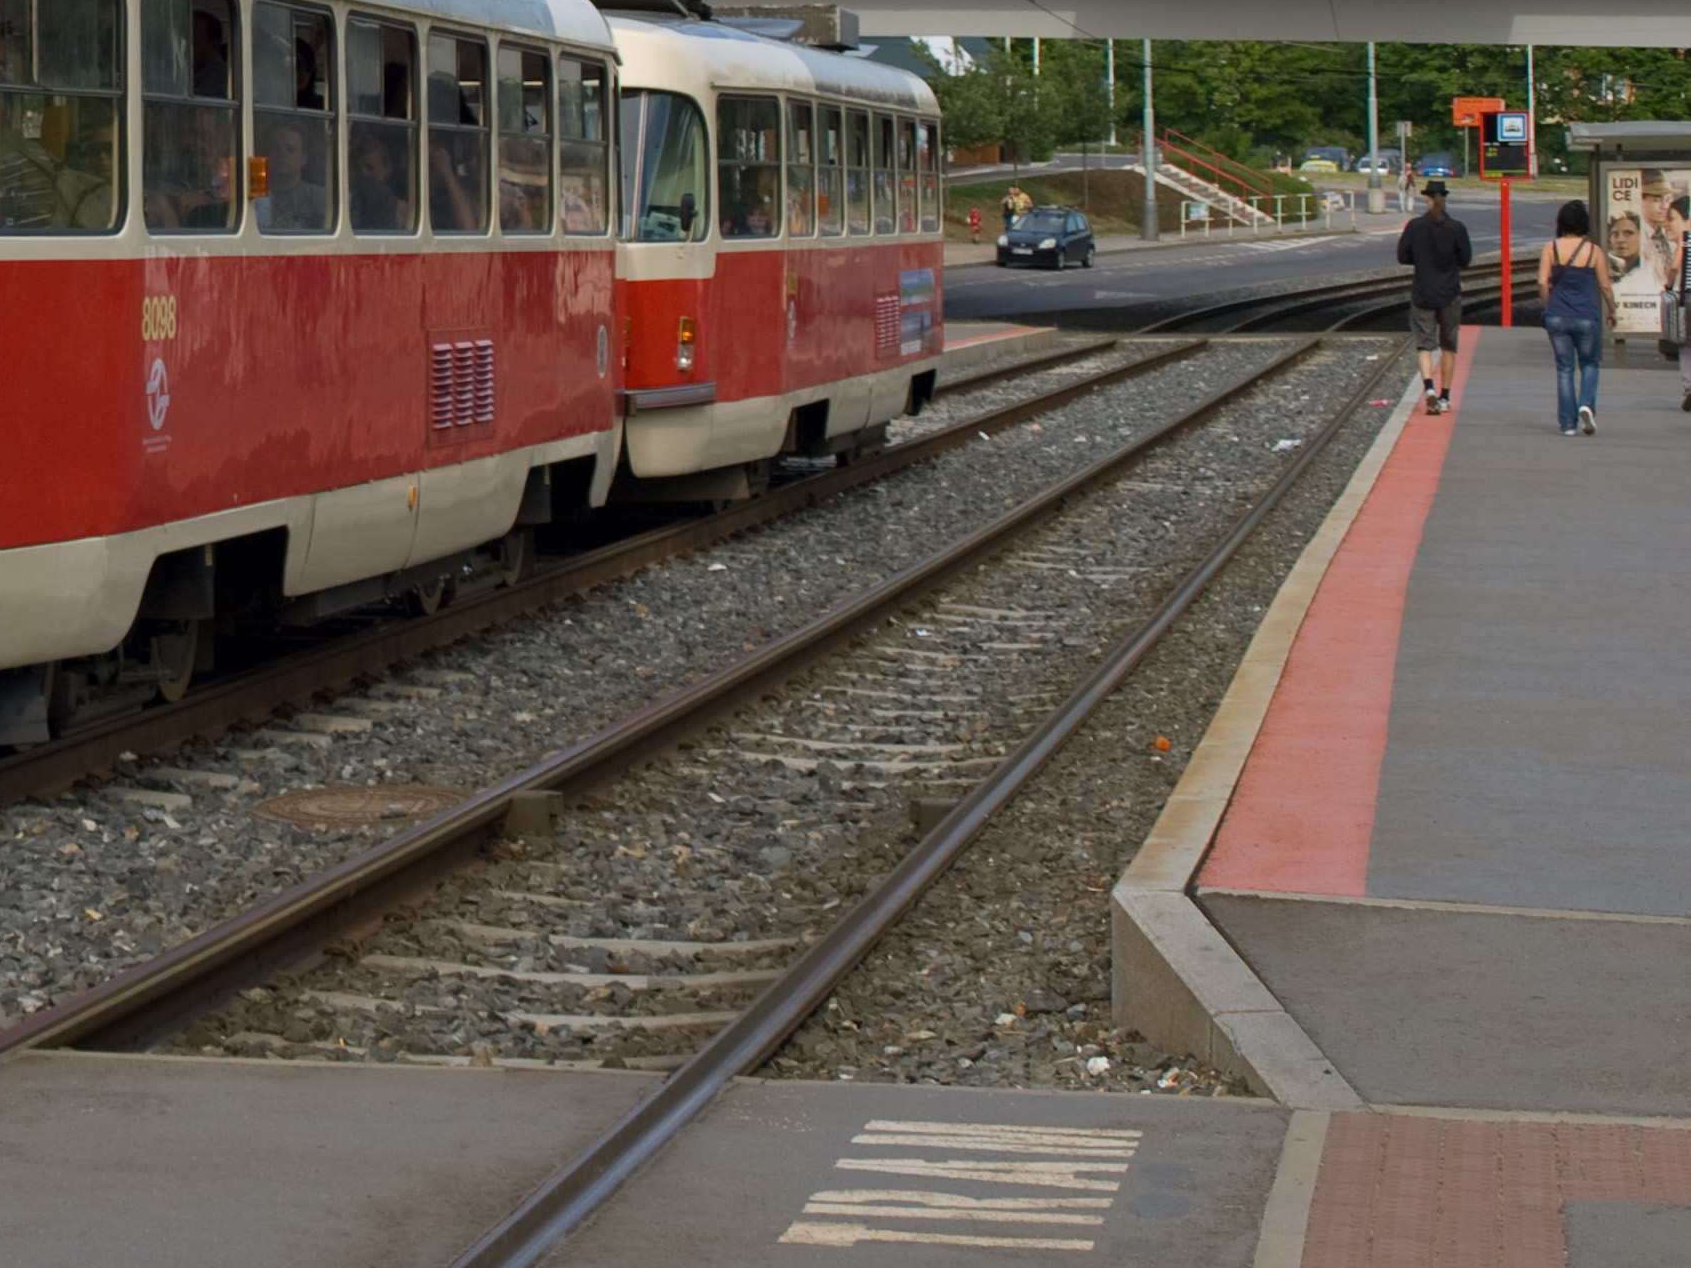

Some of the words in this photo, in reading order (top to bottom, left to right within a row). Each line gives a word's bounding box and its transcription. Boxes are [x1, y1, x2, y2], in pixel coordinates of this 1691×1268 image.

[1612, 177, 1638, 189] LIDI
[1612, 190, 1631, 202] CE
[142, 295, 177, 342] 8098
